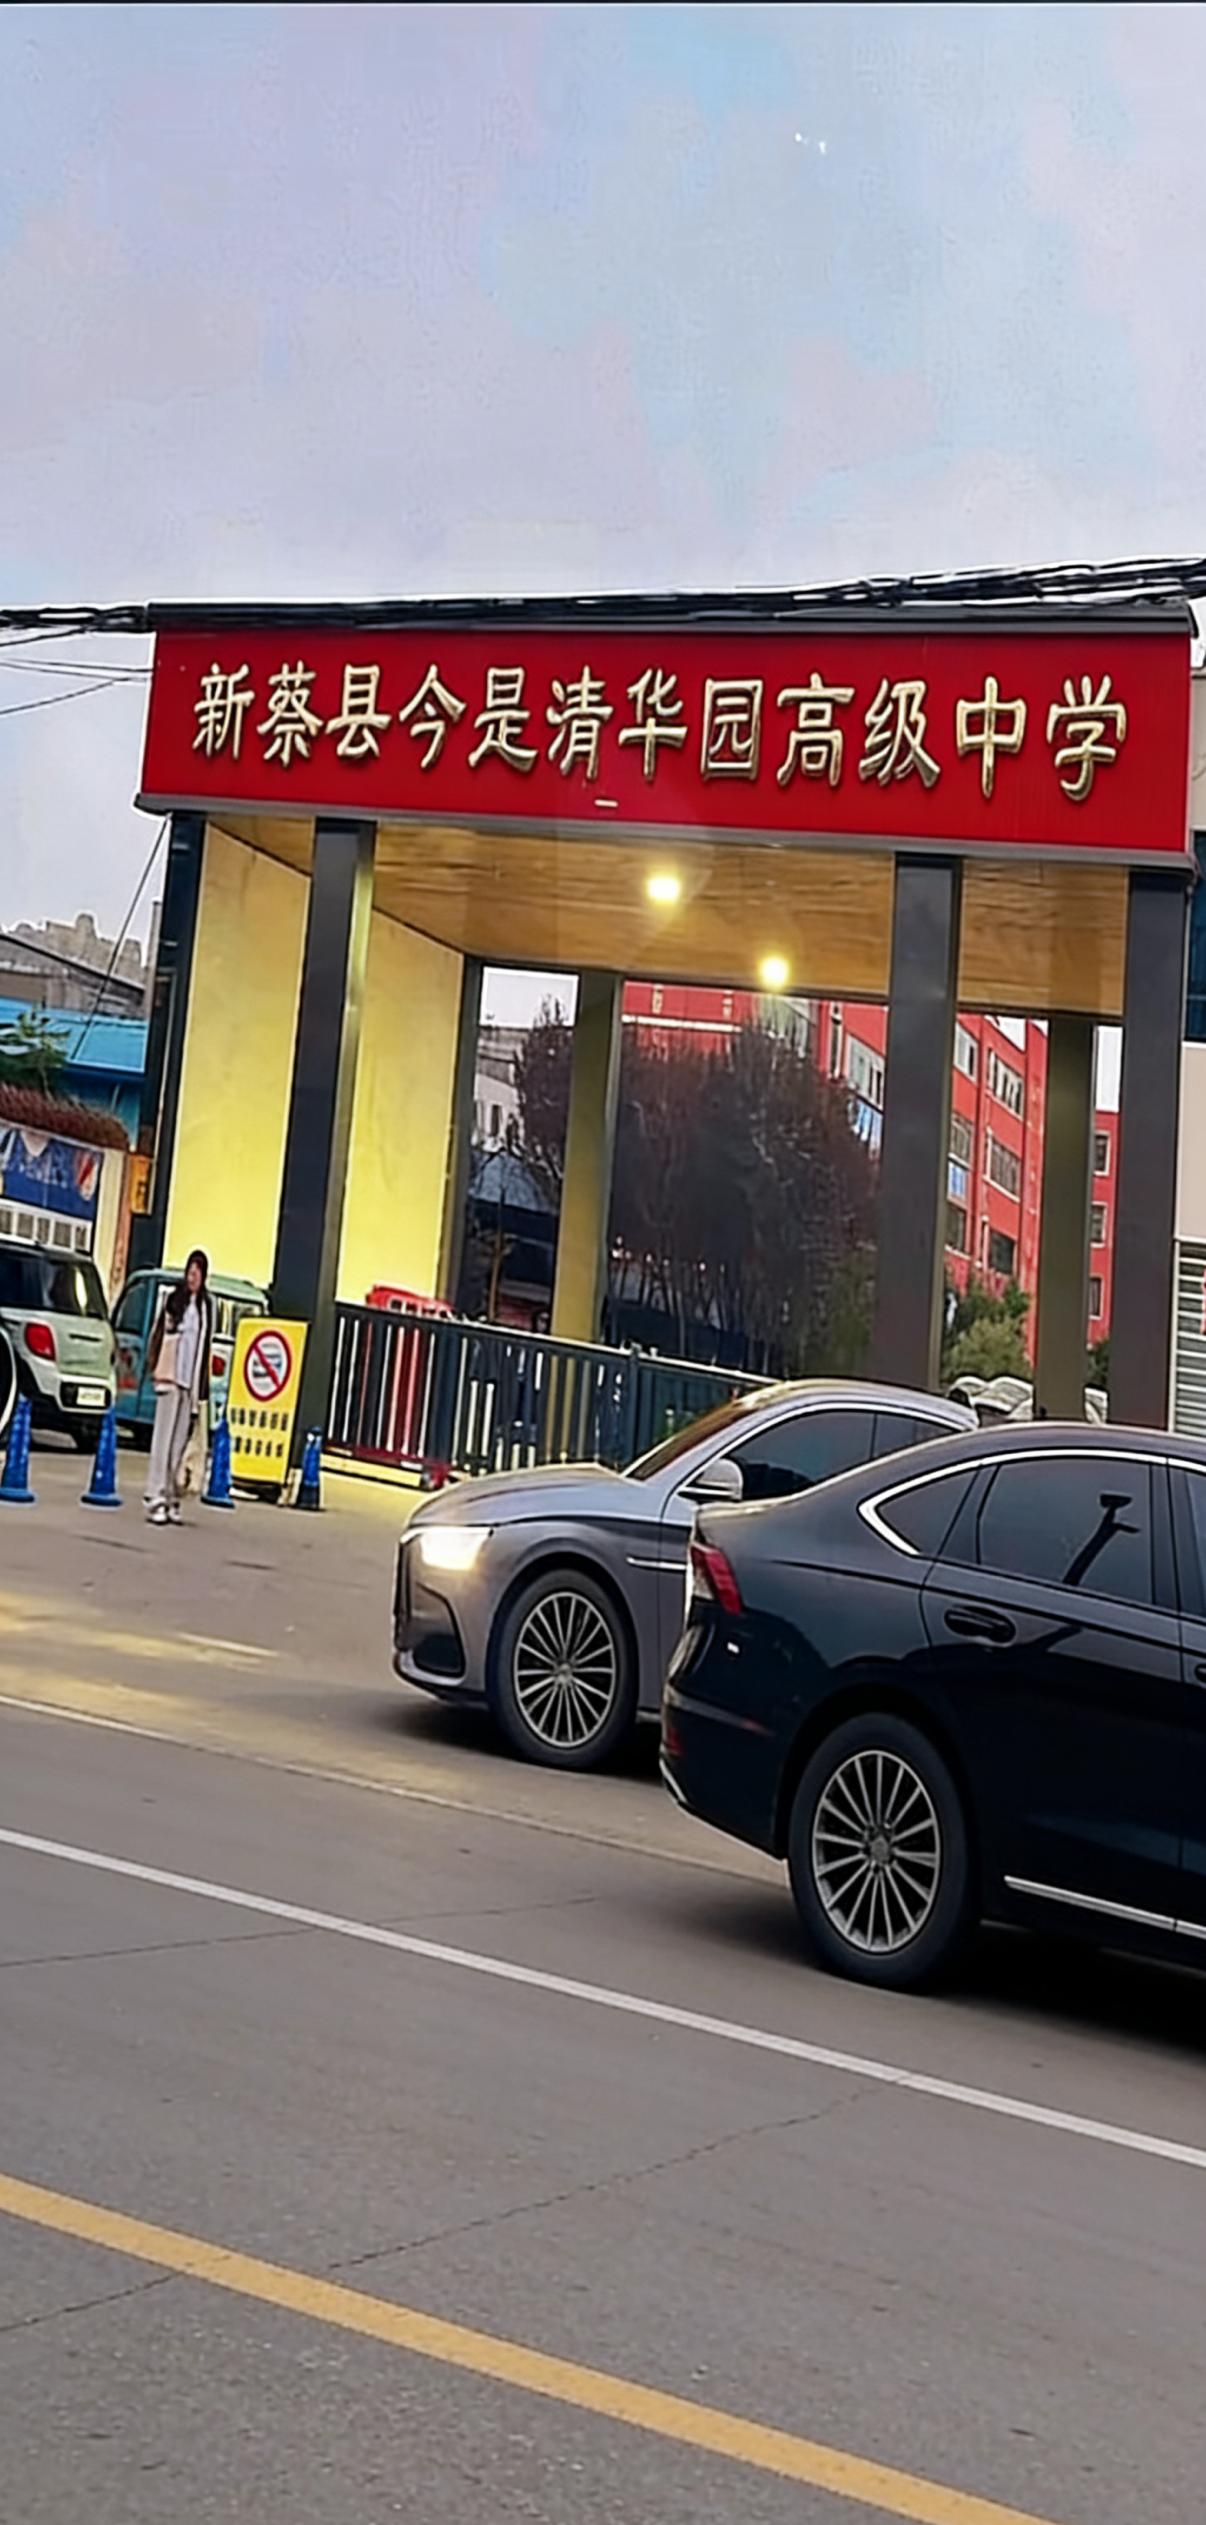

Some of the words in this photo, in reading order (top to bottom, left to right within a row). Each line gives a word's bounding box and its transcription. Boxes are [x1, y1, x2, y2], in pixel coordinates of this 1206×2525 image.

[192, 660, 1127, 800] 新蔡县今是清华园高级中学
